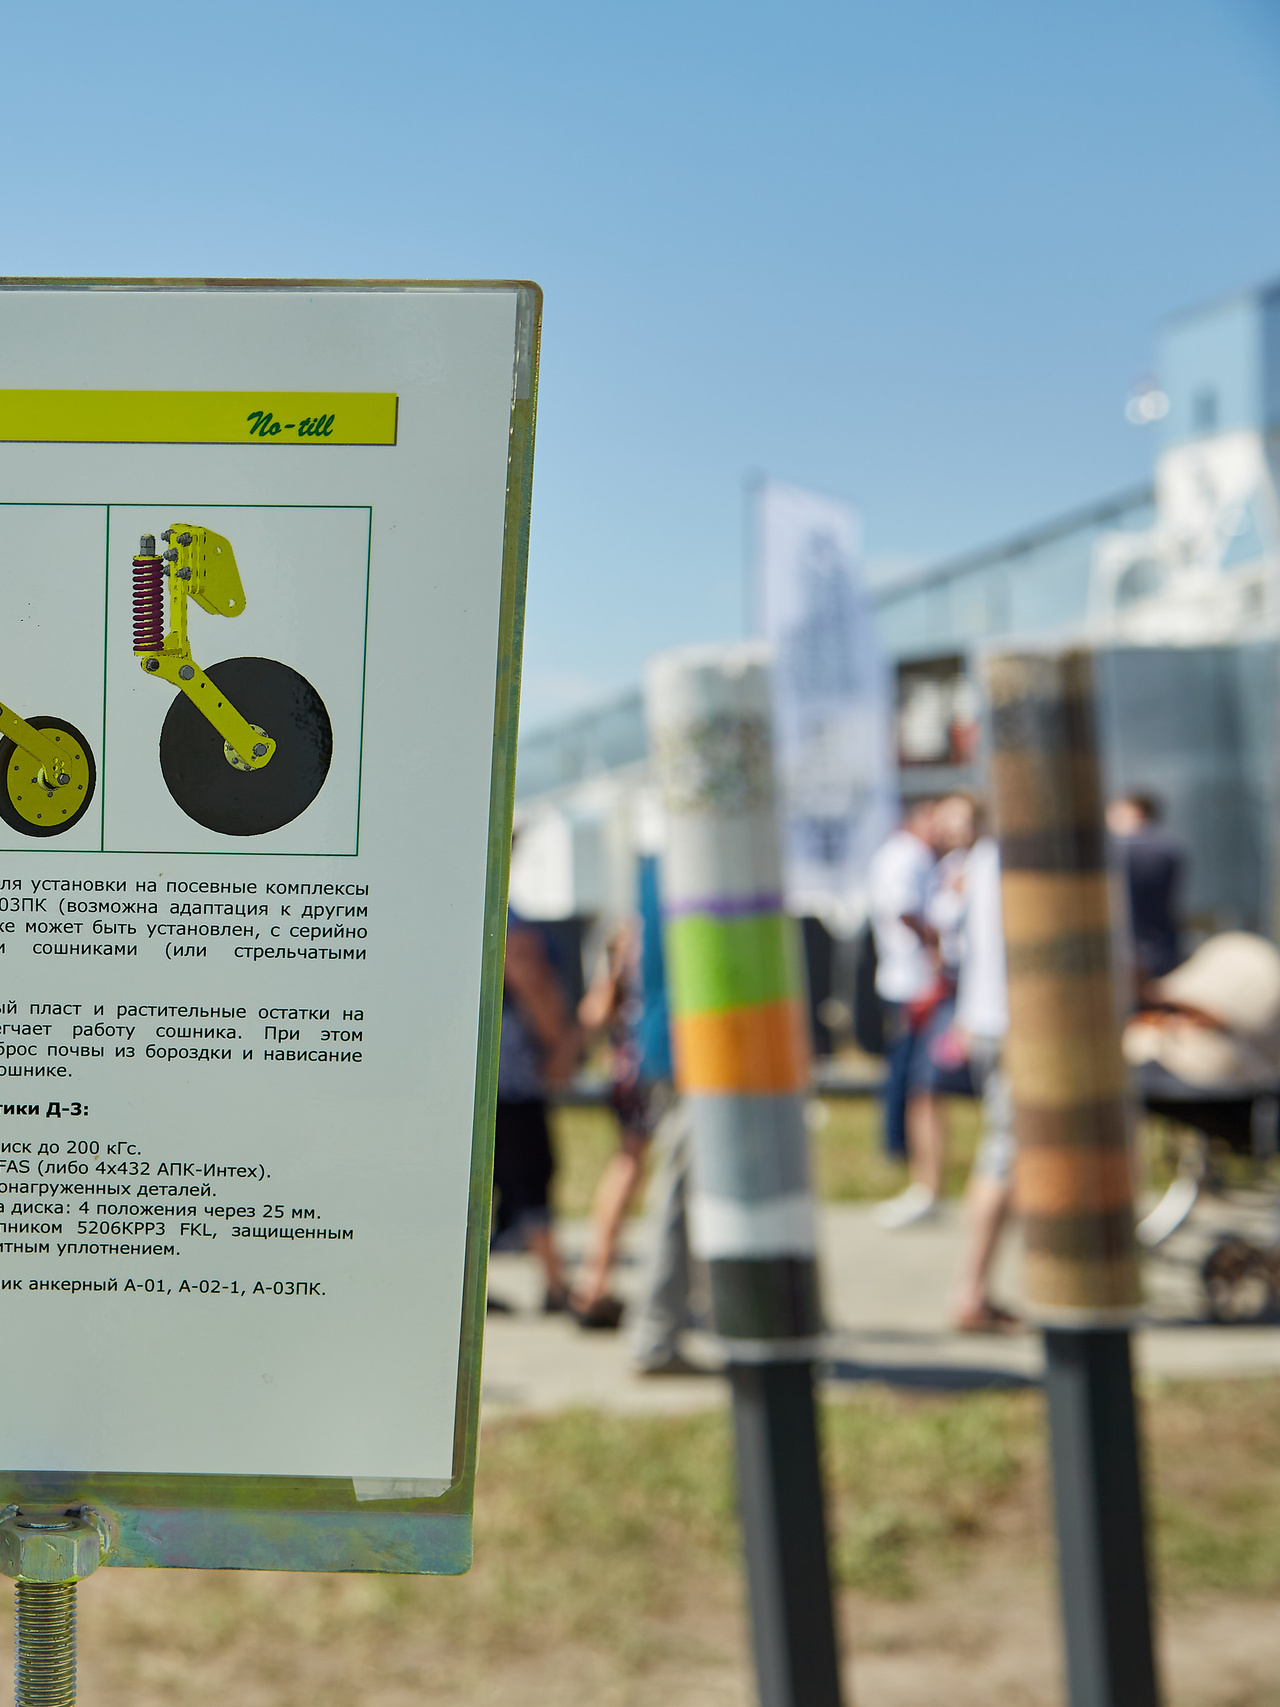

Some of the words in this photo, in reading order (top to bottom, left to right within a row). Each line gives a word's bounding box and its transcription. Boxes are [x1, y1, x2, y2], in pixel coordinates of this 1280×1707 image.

[247, 411, 335, 437] No-till
[30, 879, 127, 895] установки
[135, 880, 157, 893] на
[166, 881, 258, 895] посевные
[265, 882, 369, 896] комплексы
[58, 897, 158, 916] (возможна
[169, 902, 269, 918] адаптация
[280, 904, 292, 917] к
[300, 905, 368, 921] другим
[25, 921, 84, 934] может
[92, 919, 137, 935] быть
[146, 923, 260, 941] установлен,
[270, 925, 281, 938] с
[289, 923, 368, 942] серийно
[32, 943, 138, 956] сошниками
[165, 941, 207, 961] (или
[233, 946, 367, 962] стрельчатыми
[29, 1003, 83, 1016] пласт
[93, 1004, 104, 1016] и
[116, 1004, 247, 1020] растительные
[258, 1007, 330, 1021] остатки
[342, 1009, 364, 1022] на
[72, 1021, 136, 1041] работу
[155, 1026, 242, 1040] сошника.
[264, 1025, 300, 1044] При
[320, 1029, 363, 1042] этом
[47, 1045, 105, 1058] почвы
[115, 1046, 136, 1058] из
[145, 1043, 232, 1062] бороздки
[242, 1048, 253, 1061] и
[263, 1049, 363, 1063] нависание
[45, 1101, 89, 1119] Д-3:
[37, 1142, 60, 1157] до
[66, 1140, 100, 1156] 200
[106, 1141, 142, 1156] кГс.
[37, 1159, 89, 1178] (либо
[156, 1162, 271, 1182] АПК-Интех).
[136, 1182, 217, 1198] деталей.
[10, 1202, 71, 1216] диска:
[78, 1200, 90, 1215] 4
[96, 1203, 197, 1217] положения
[203, 1206, 256, 1221] через
[262, 1204, 285, 1219] 25
[291, 1208, 321, 1220] мм.
[180, 1222, 218, 1240] FKL,
[231, 1226, 354, 1241] защищенным
[56, 1242, 181, 1258] уплотнением.
[28, 1277, 118, 1295] анкерный
[123, 1278, 172, 1296] А-01,
[178, 1279, 246, 1297] А-02-1,
[252, 1280, 326, 1296] А-03ПК.
